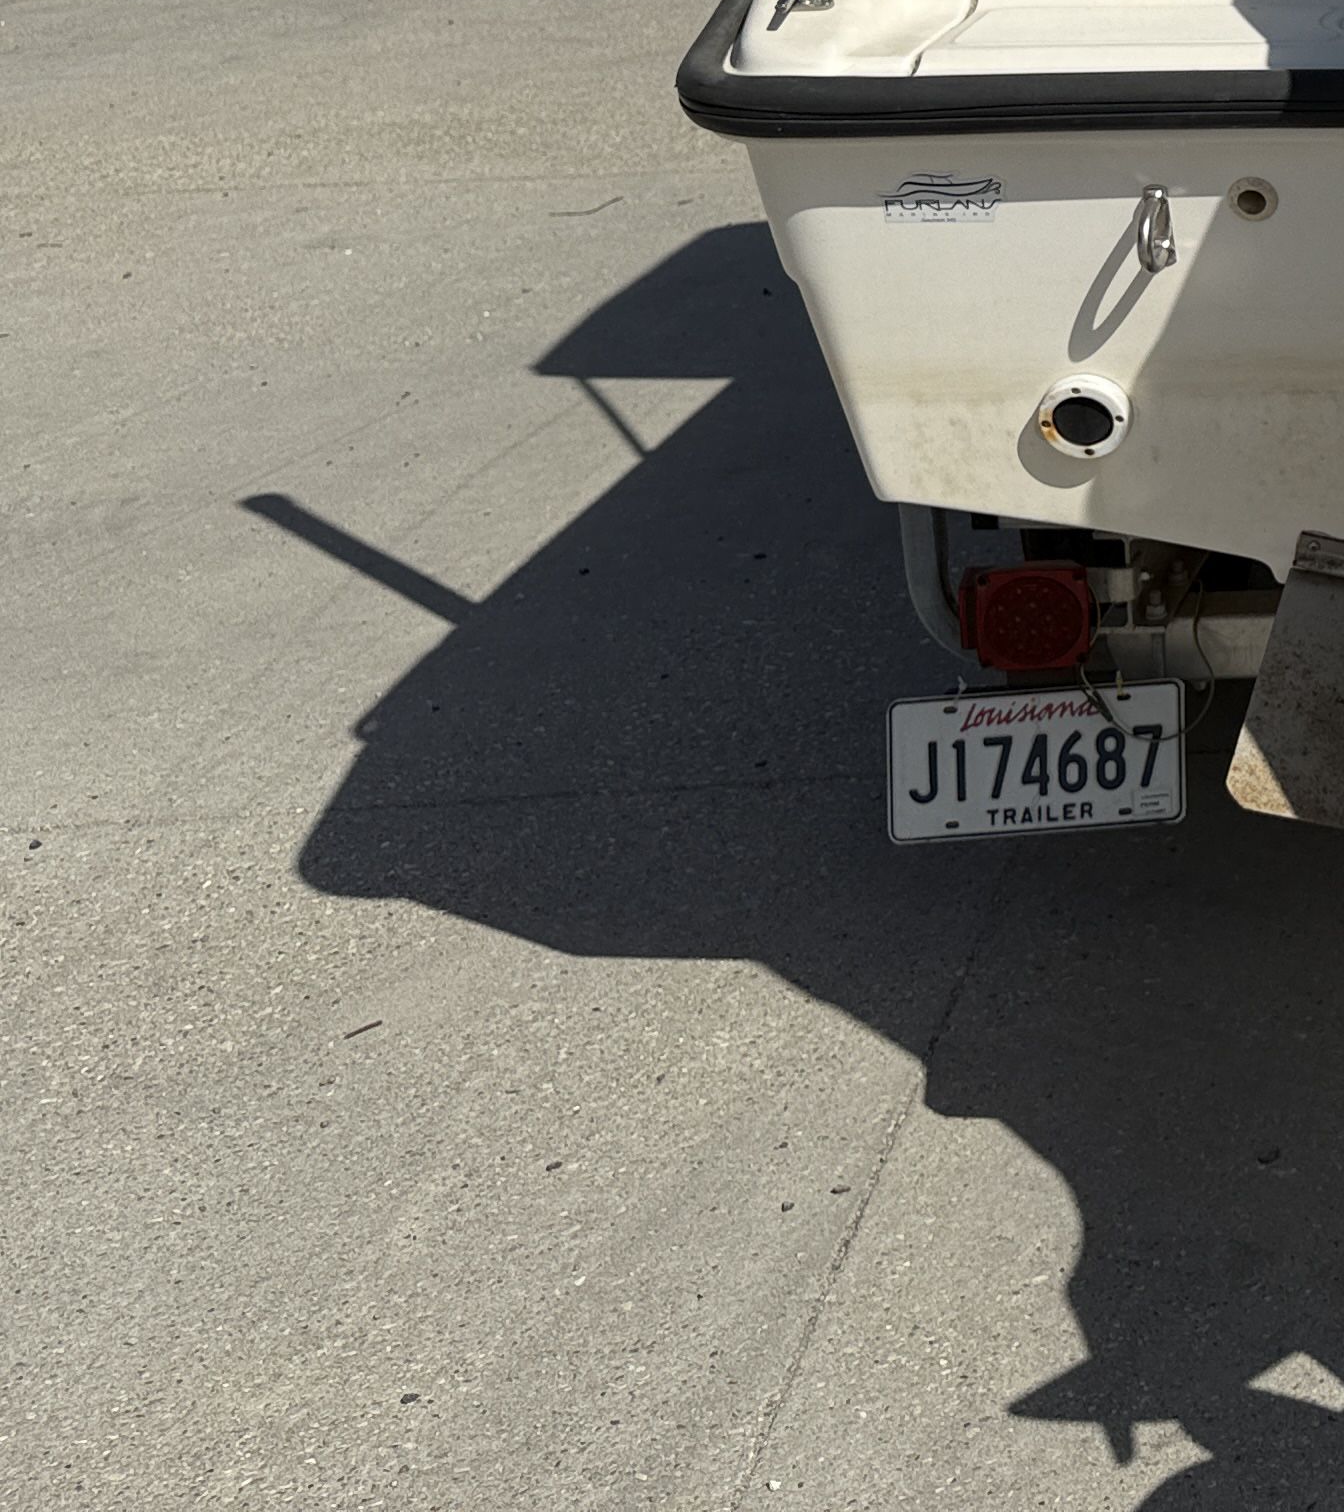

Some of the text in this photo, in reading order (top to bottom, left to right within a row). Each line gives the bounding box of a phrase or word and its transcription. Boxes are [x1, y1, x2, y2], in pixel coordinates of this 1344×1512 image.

[884, 199, 1002, 211] FURLANS
[960, 698, 1101, 732] Louisiana
[909, 724, 1163, 804] J174687
[987, 802, 1094, 826] TRAILER
